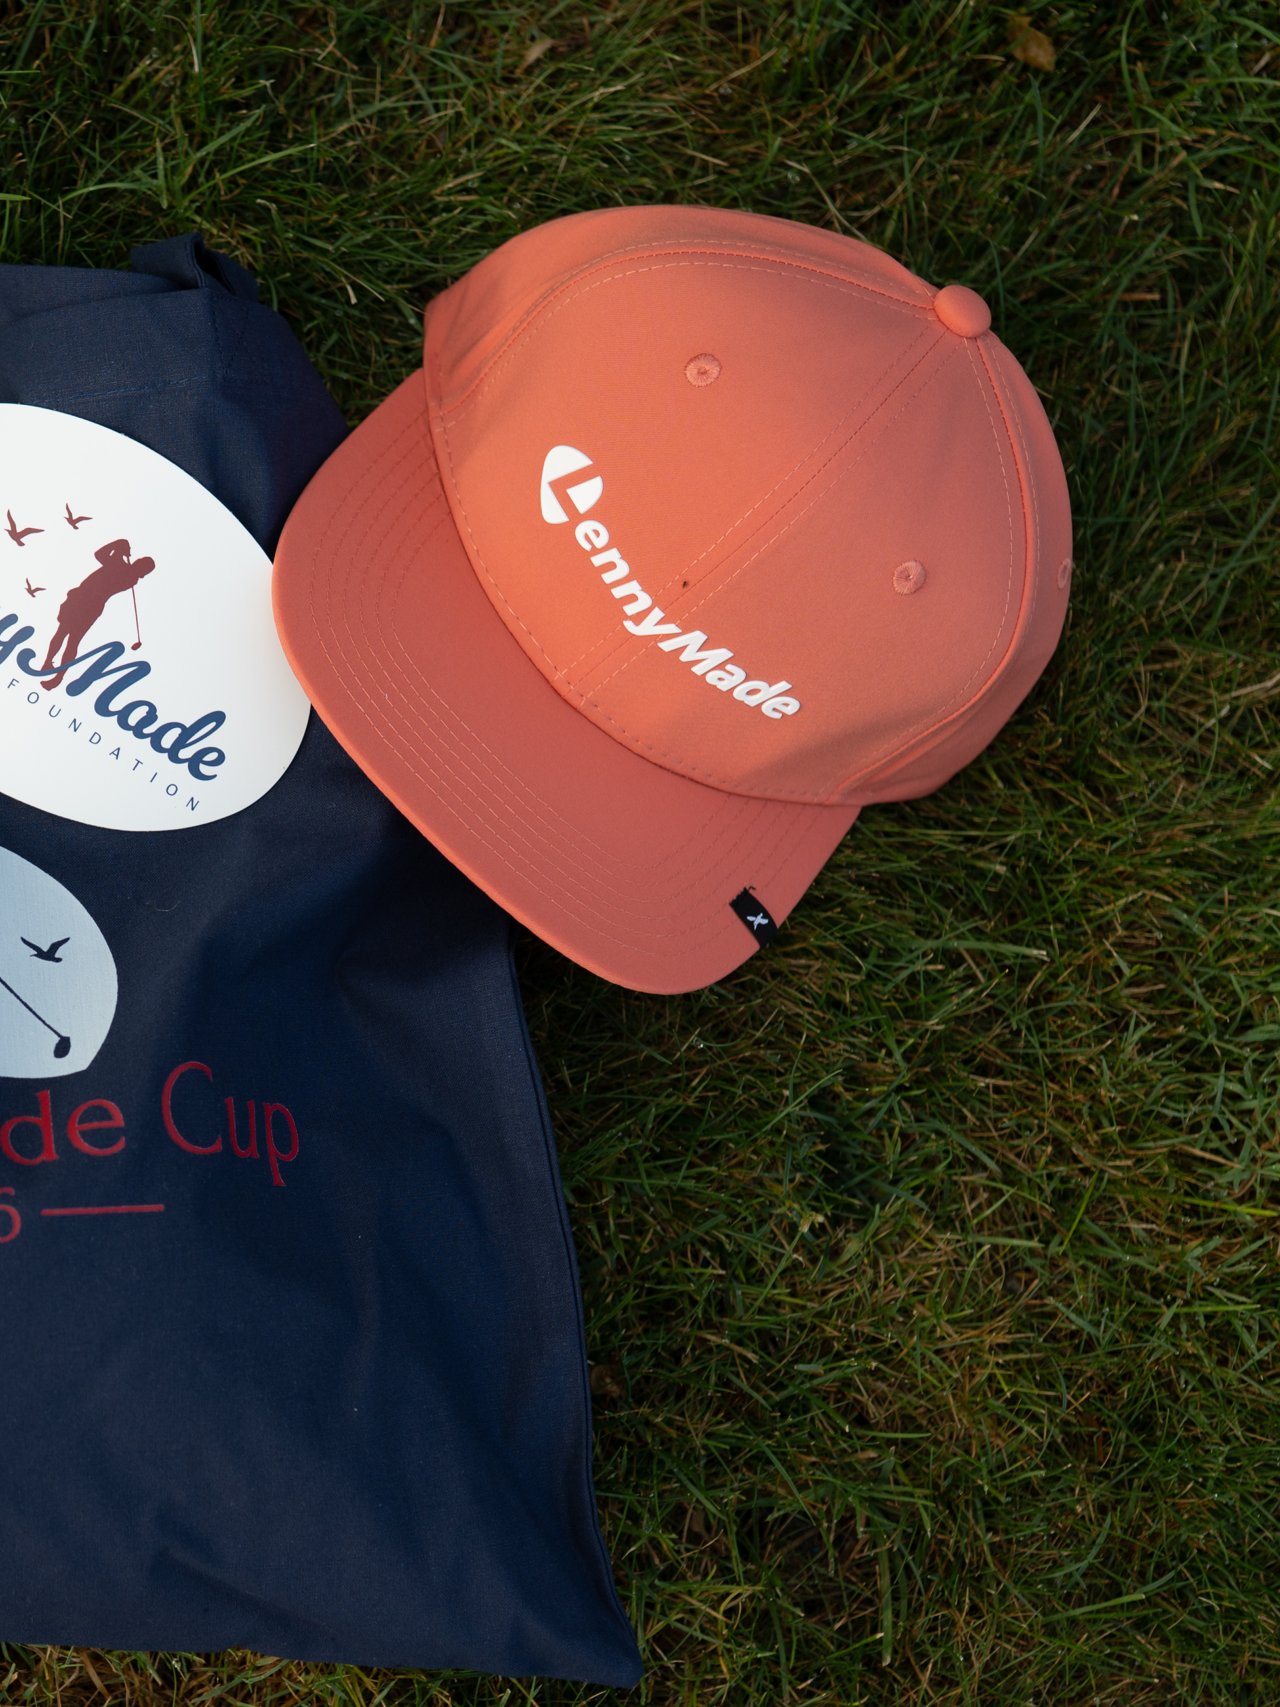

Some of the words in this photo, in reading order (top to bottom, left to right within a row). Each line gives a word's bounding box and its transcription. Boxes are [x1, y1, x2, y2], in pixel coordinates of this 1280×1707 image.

[539, 444, 802, 720] LennyMade
[6, 677, 201, 812] FOUNDATION
[161, 1060, 301, 1188] Cup
